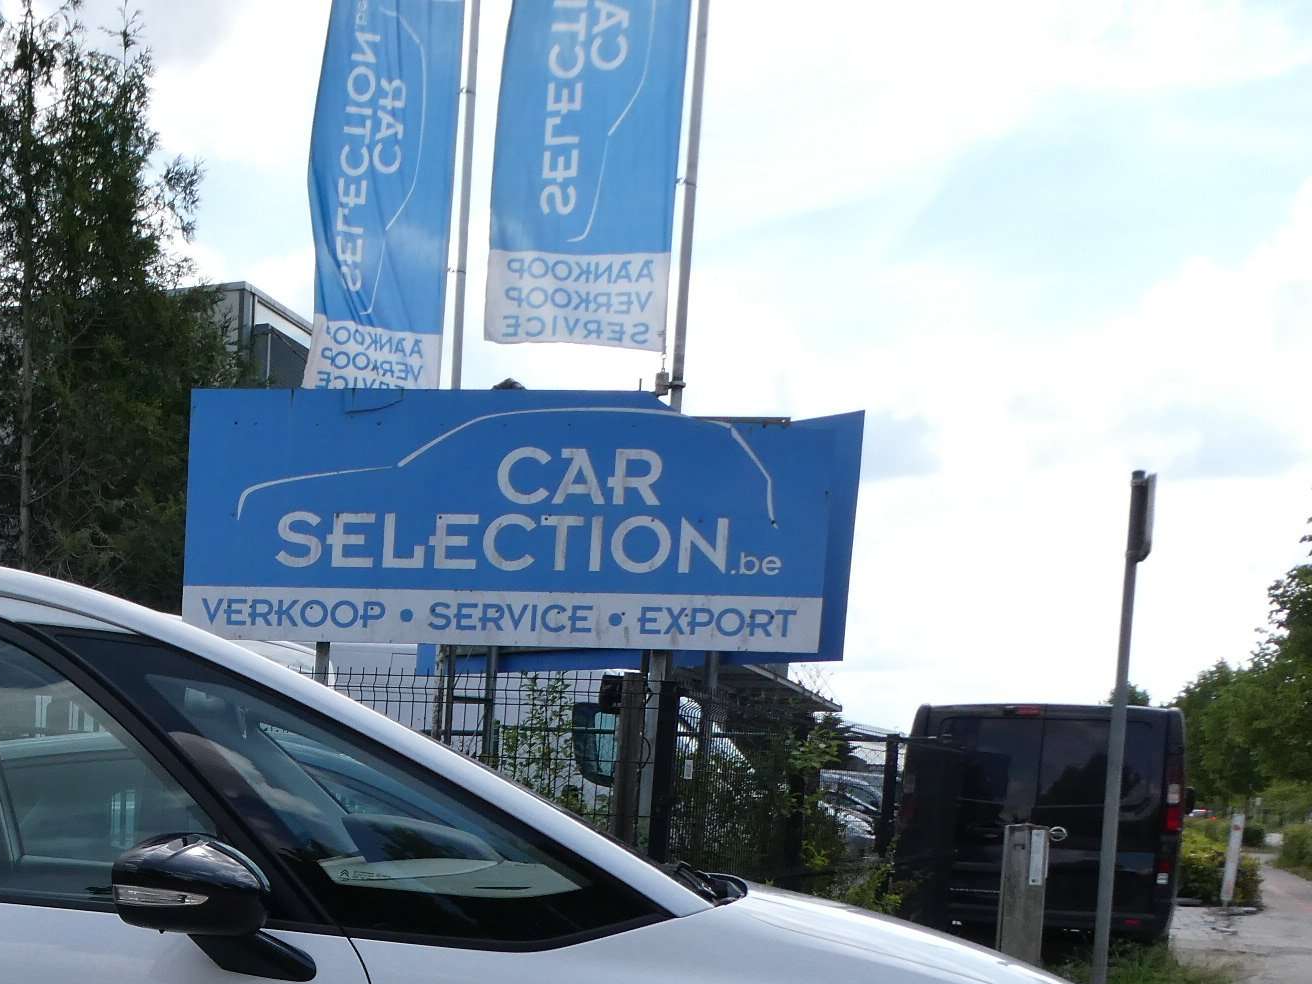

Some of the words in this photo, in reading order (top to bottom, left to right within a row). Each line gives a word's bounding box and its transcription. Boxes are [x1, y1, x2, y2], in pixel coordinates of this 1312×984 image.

[496, 446, 664, 506] CAR
[201, 597, 387, 629] VERKOOP
[428, 602, 595, 634] SERVICE
[638, 606, 798, 638] EXPORT
